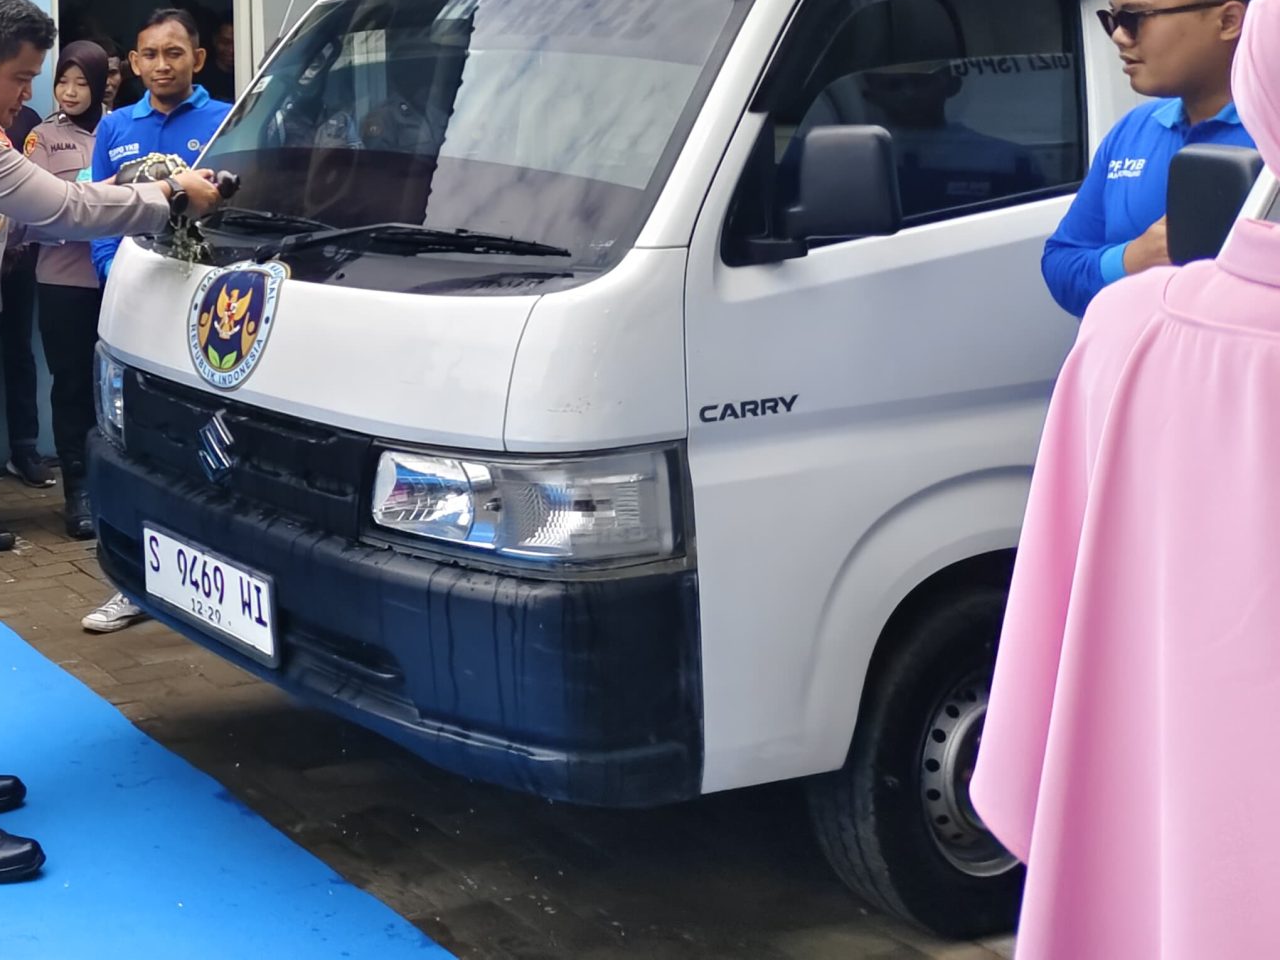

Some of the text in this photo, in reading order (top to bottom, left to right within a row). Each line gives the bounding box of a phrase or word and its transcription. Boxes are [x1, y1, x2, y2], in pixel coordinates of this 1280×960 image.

[50, 142, 77, 153] HALMA
[191, 323, 263, 385] REPUBLIK INDONESIA
[699, 393, 800, 423] CARRY
[149, 534, 269, 629] S 9469 WI
